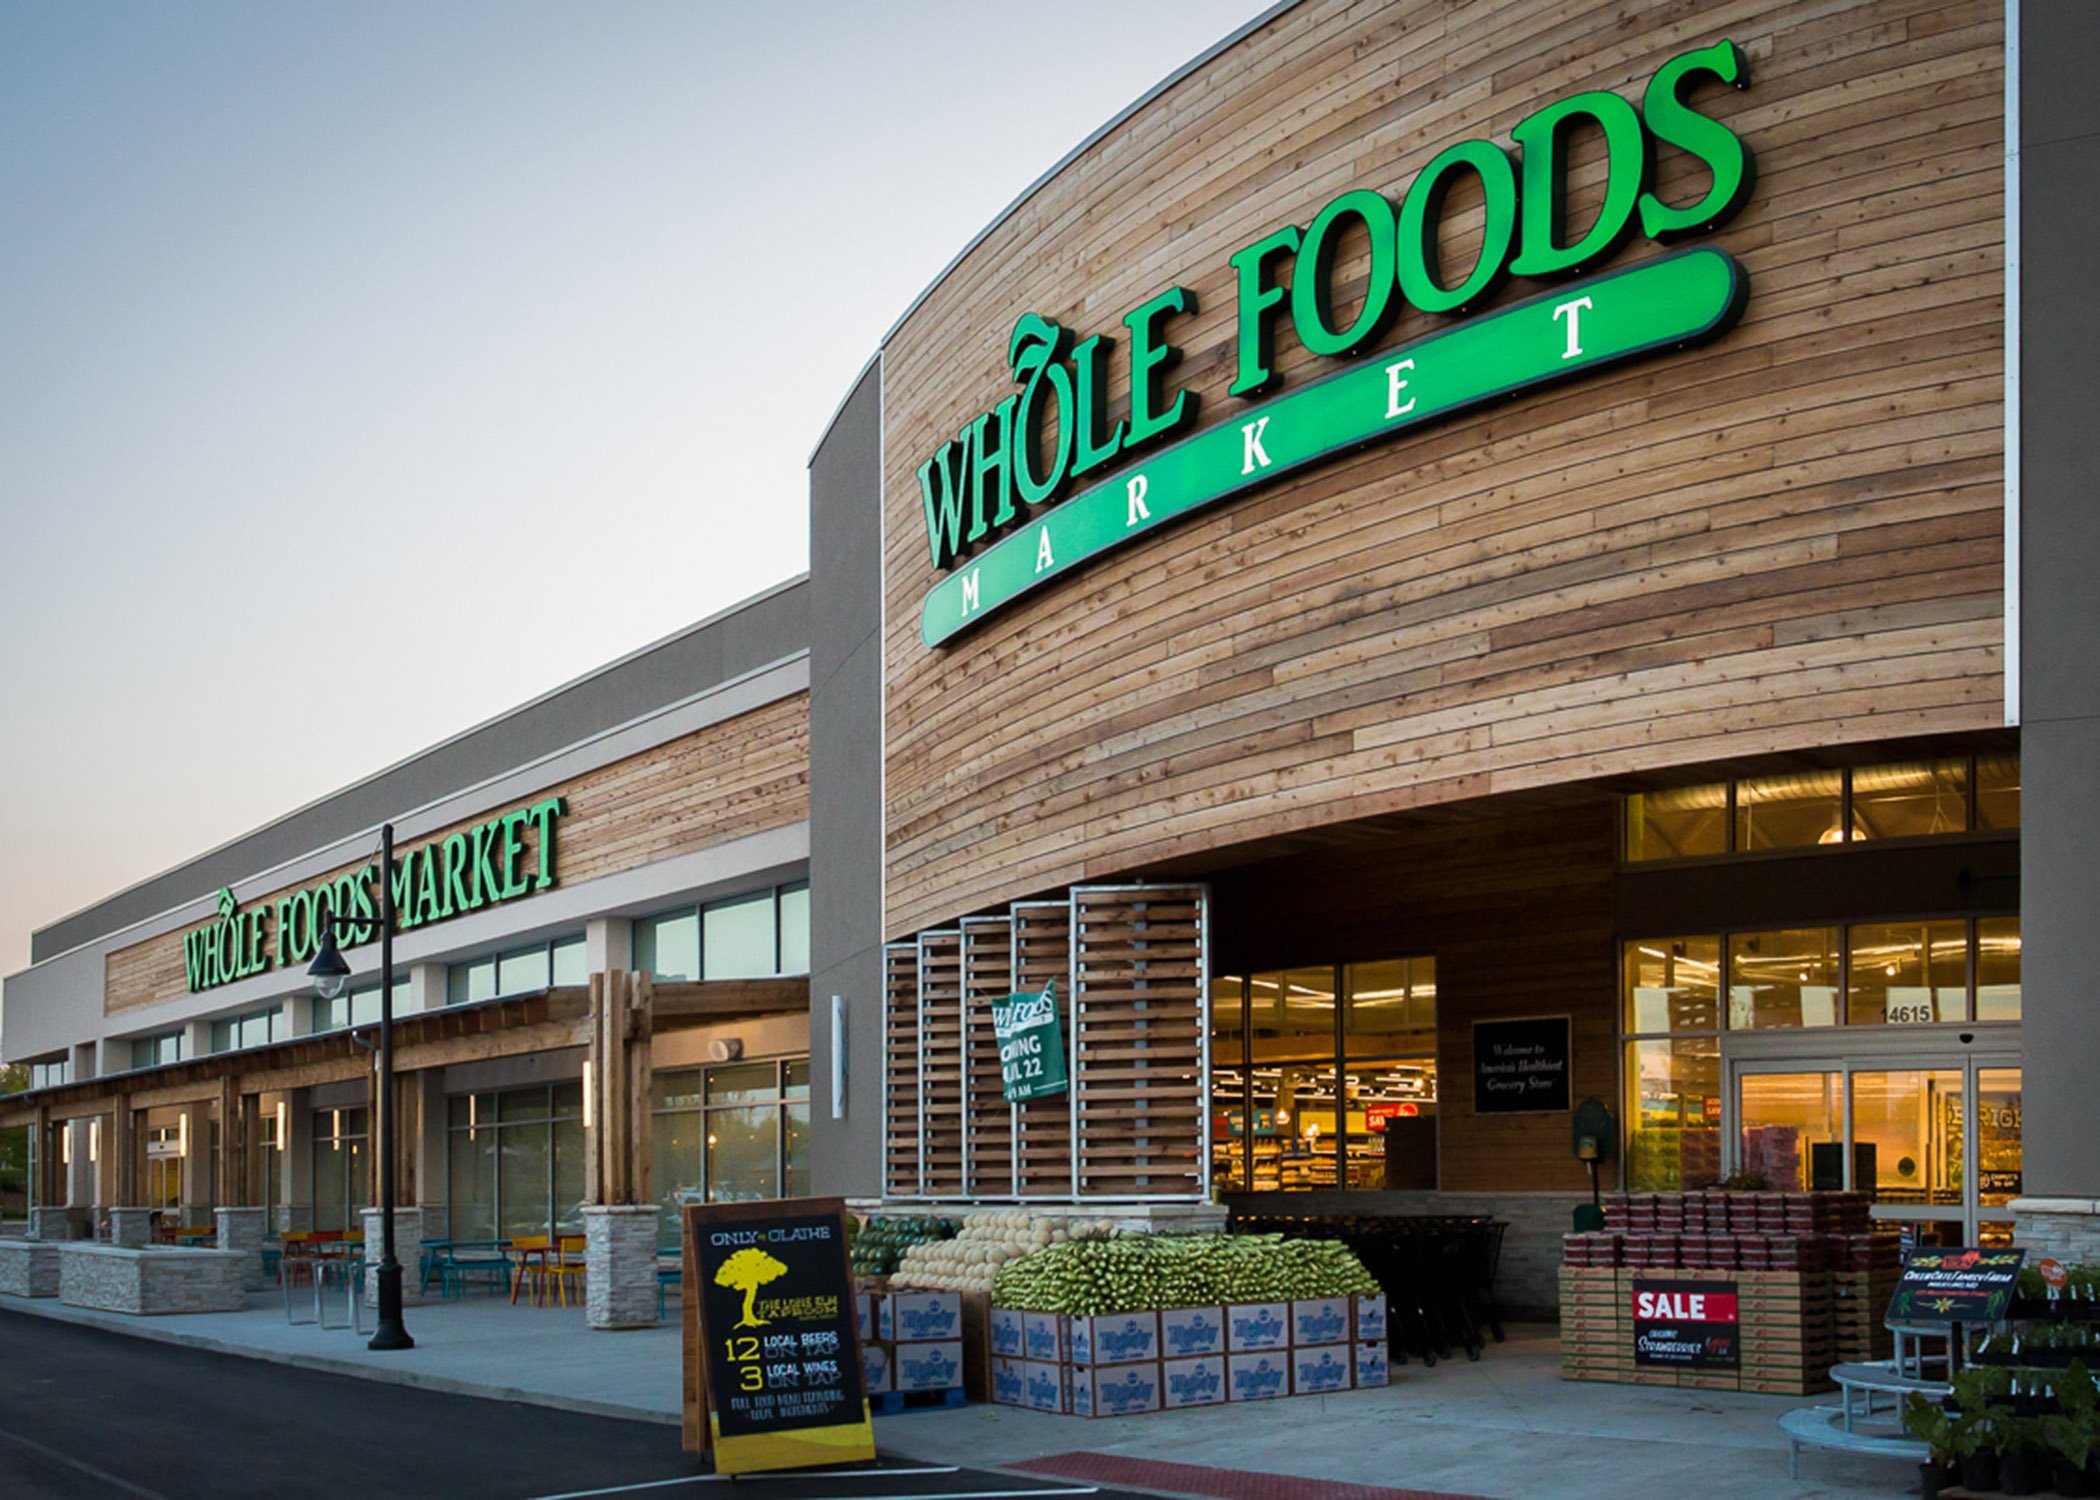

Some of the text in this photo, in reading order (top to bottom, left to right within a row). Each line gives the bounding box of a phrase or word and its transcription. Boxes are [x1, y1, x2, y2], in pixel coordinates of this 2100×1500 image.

[916, 39, 1746, 569] WHOLE FOODS
[961, 296, 1593, 617] MARKET
[183, 797, 563, 993] WHOLE FOODS MARKET
[1023, 1058, 1043, 1078] 22
[710, 1226, 831, 1246] ONLY OLATHE
[1638, 1292, 1706, 1319] SALE
[725, 1331, 838, 1361] 12 LOCAL BEERS
[764, 1342, 840, 1358] ON TAP
[740, 1360, 837, 1390] 3 LOCAL WINES
[768, 1371, 841, 1388] ON TAP
